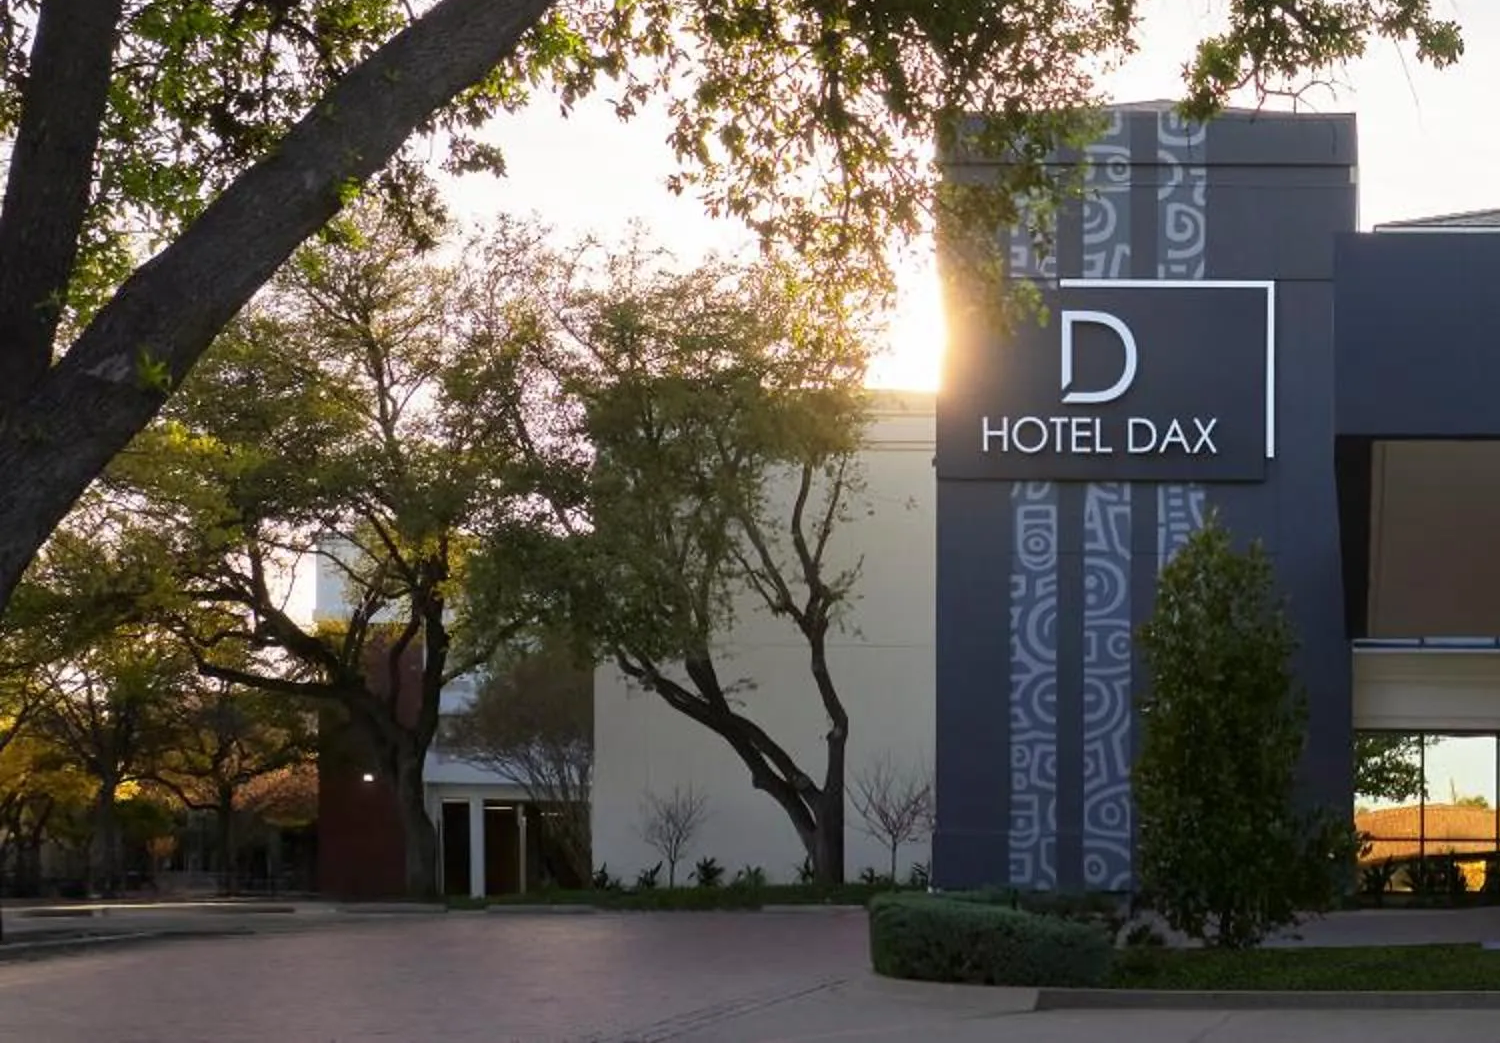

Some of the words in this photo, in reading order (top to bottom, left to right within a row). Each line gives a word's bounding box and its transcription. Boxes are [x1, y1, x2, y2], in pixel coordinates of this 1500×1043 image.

[1061, 310, 1138, 404] D
[981, 416, 1113, 454] HOTEL
[1127, 417, 1218, 454] DAX
